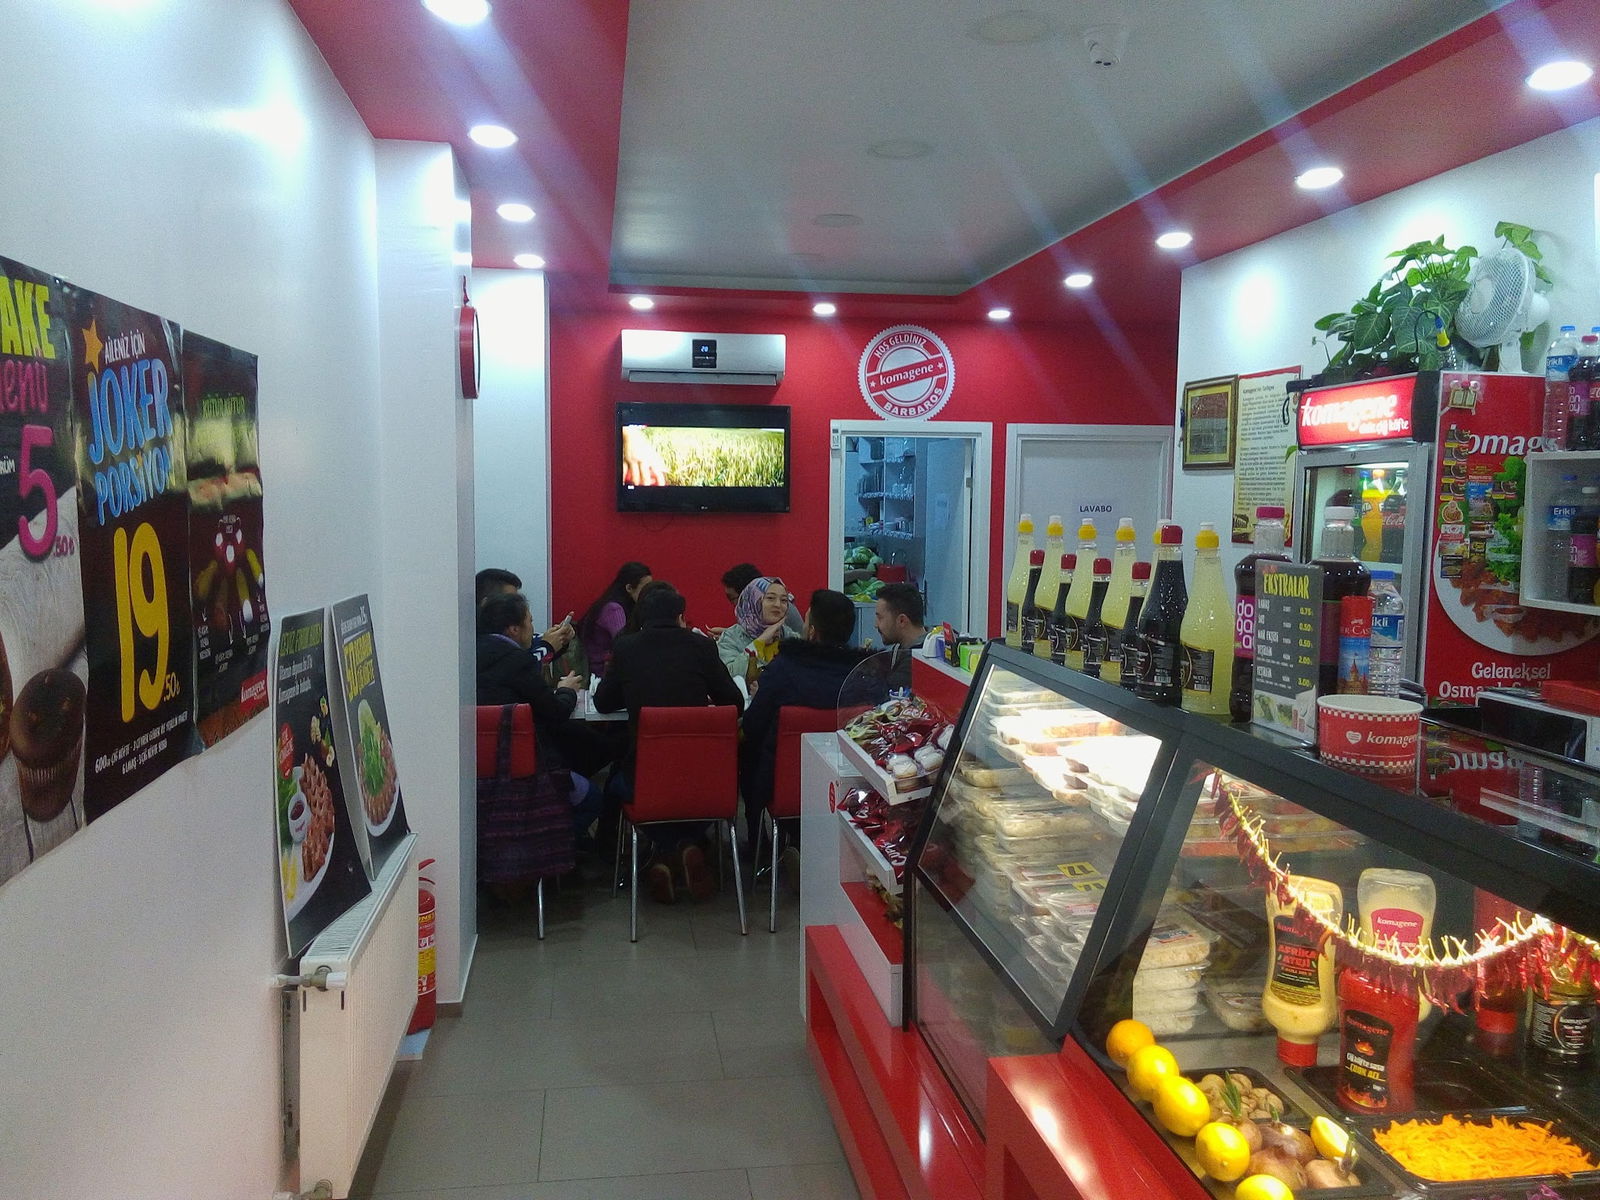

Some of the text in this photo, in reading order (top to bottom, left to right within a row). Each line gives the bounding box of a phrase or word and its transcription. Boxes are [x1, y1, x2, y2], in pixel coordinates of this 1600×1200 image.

[874, 342, 890, 358] HOŞ
[879, 364, 934, 386] komagene
[88, 359, 173, 464] JOKER
[883, 387, 943, 416] BARBAROS
[19, 424, 58, 556] 5
[1079, 505, 1113, 513] LAVABO
[1263, 573, 1310, 599] EKSTRALAR
[113, 522, 169, 722] 19
[1471, 661, 1551, 681] Geleneksel
[1377, 916, 1418, 928] komagene
